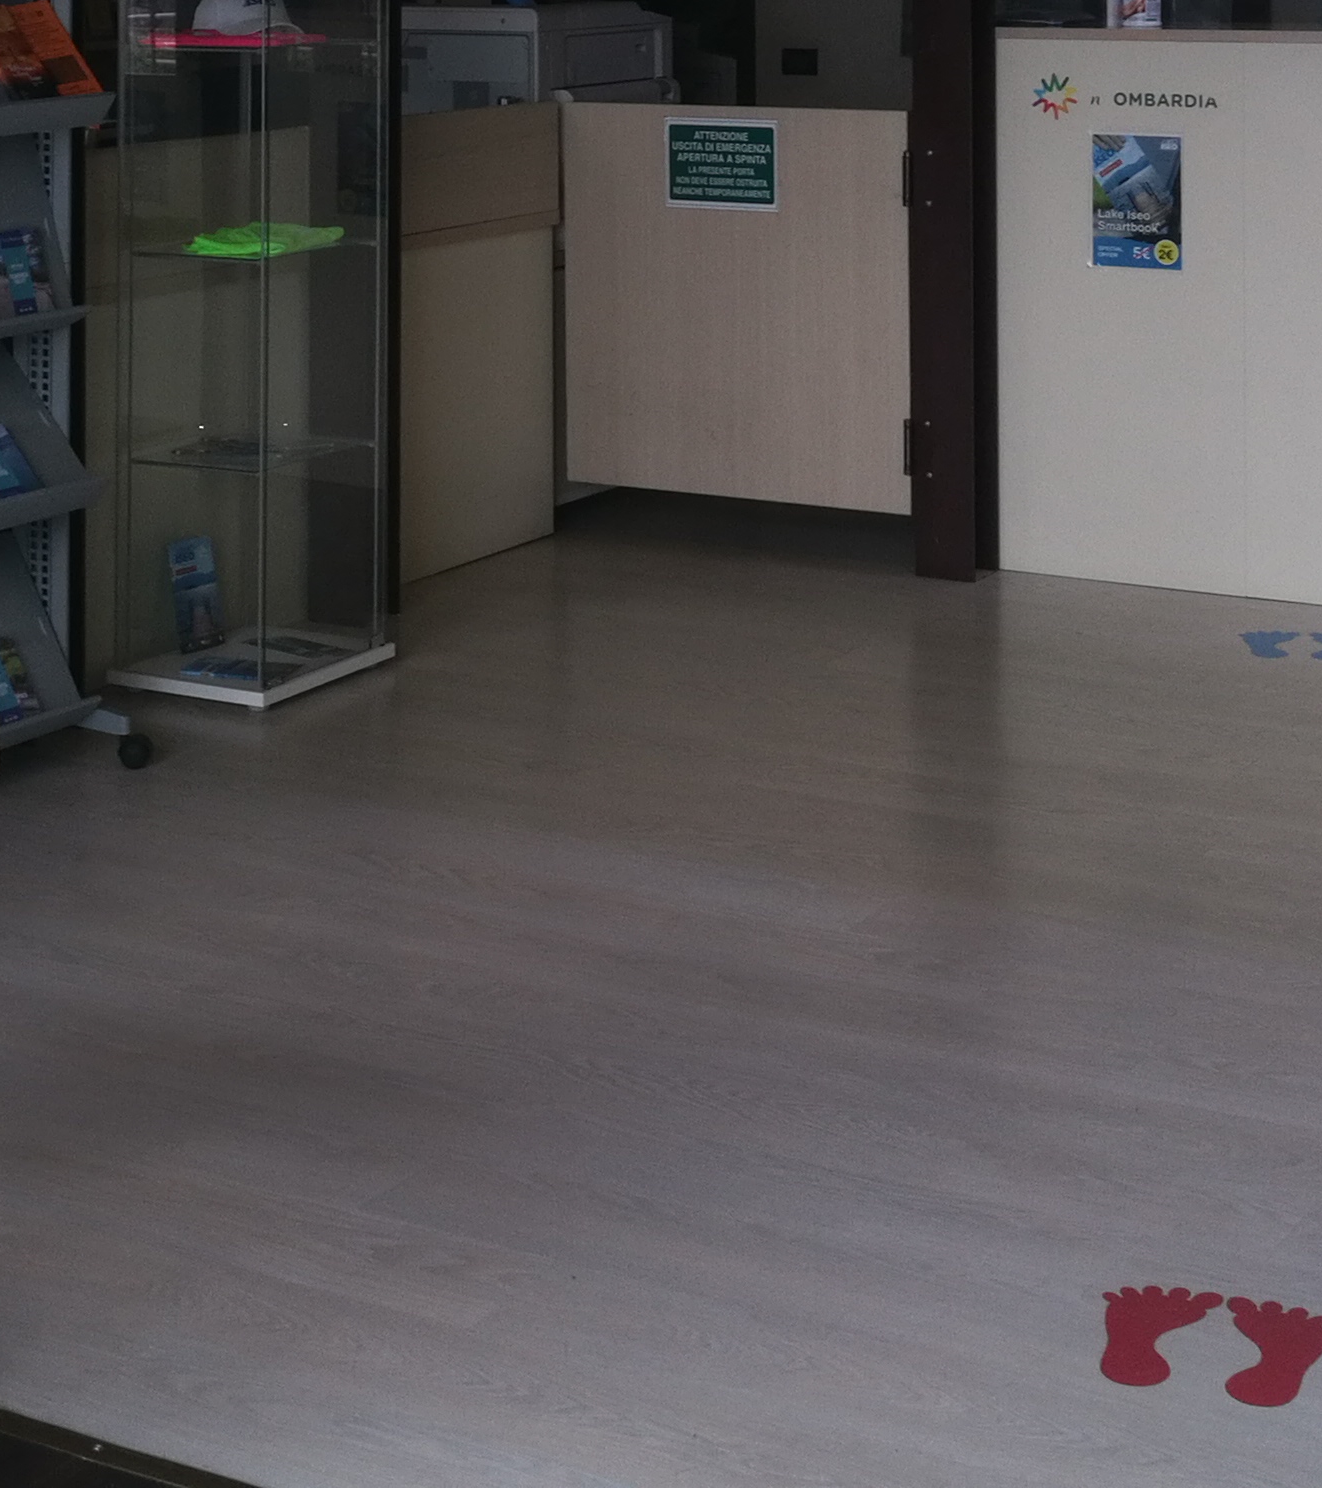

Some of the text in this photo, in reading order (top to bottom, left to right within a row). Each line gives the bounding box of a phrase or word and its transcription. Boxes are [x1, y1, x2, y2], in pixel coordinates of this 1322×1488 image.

[694, 130, 749, 141] ATTENZIONE
[672, 141, 771, 154] USCITA DI EMERGENZA
[677, 152, 767, 165] APERTURA A SPINTA
[687, 165, 697, 174] LA
[1098, 209, 1151, 220] Lake Iseo
[1098, 221, 1160, 233] Smartbook
